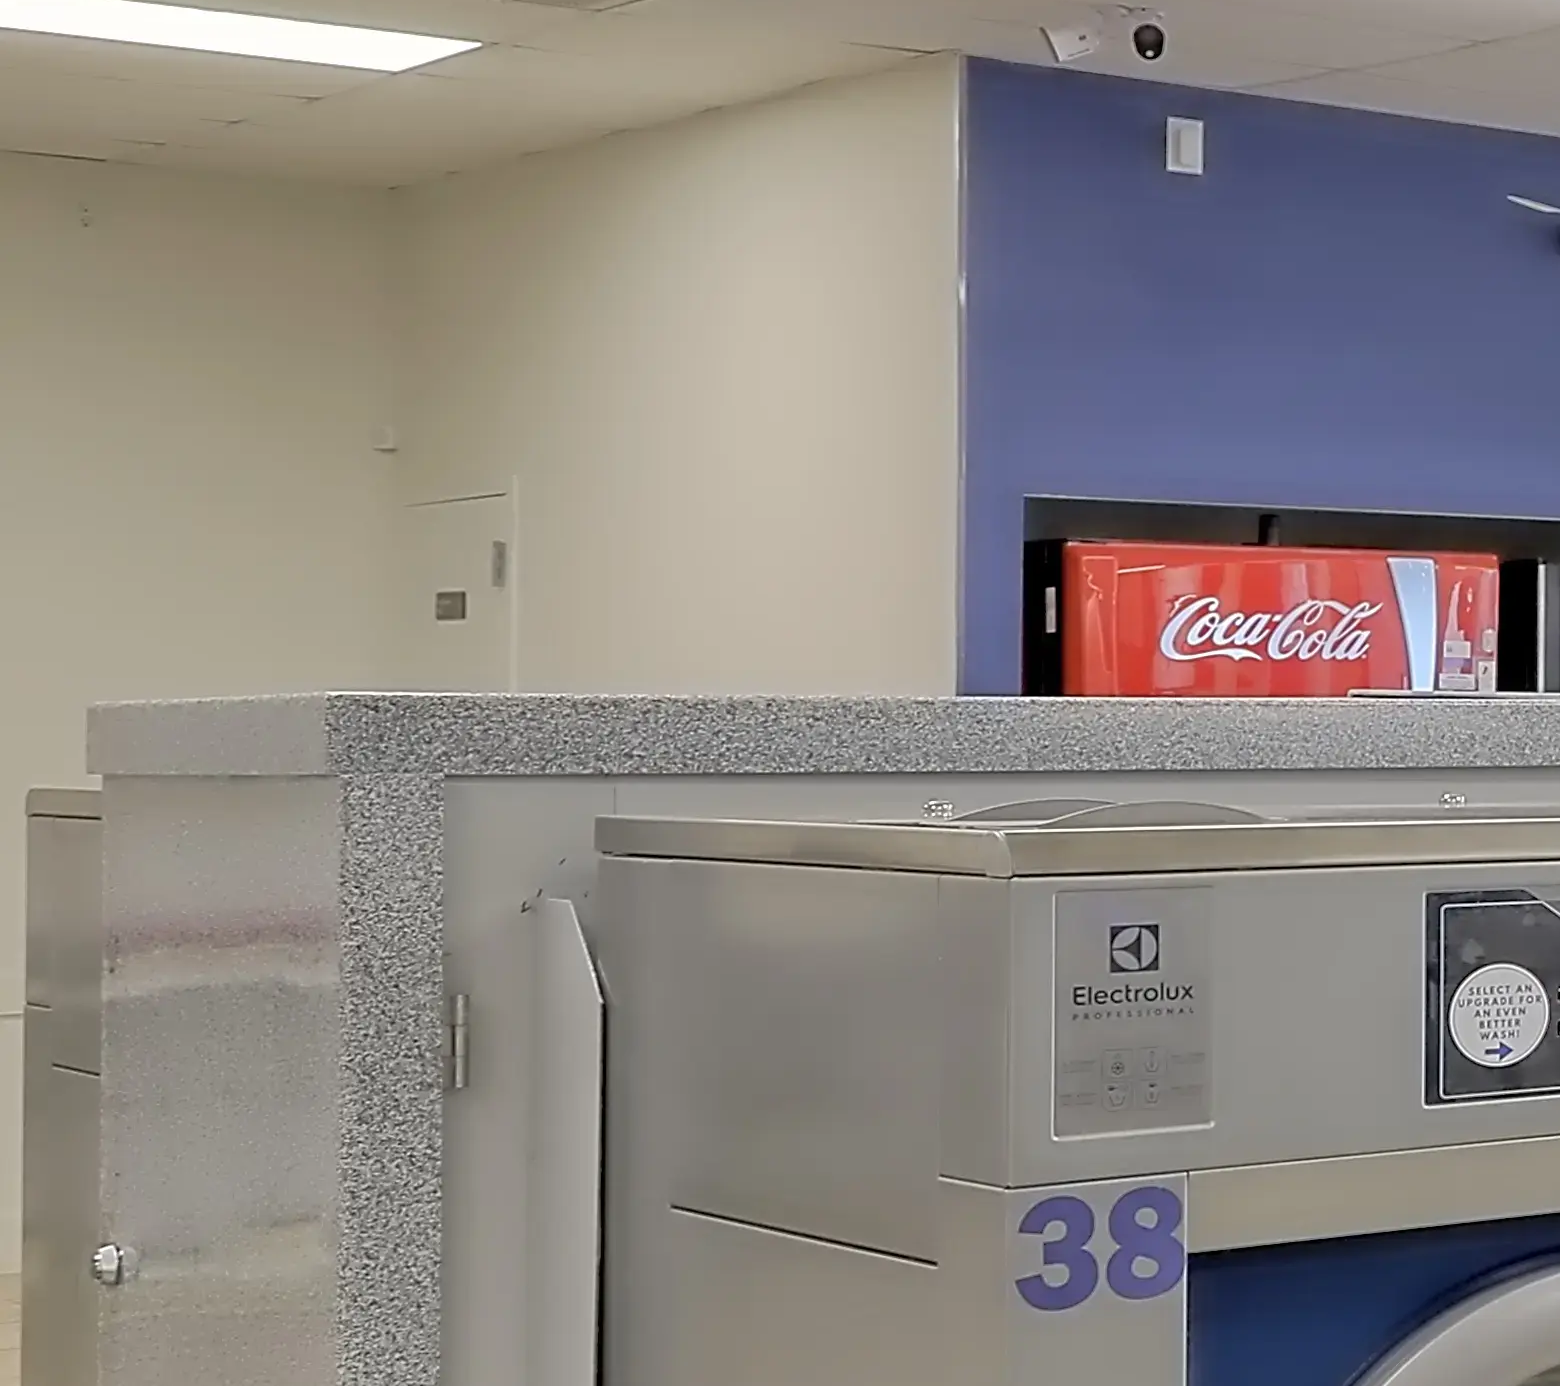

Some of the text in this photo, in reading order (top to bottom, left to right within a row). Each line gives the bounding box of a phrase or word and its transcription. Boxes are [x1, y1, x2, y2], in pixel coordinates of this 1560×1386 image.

[1160, 594, 1384, 662] Coca-Cola
[1072, 981, 1195, 1006] Electrolux
[1467, 983, 1533, 996] SELECT AN
[1457, 995, 1542, 1008] UPGRADE FOR
[1473, 1006, 1527, 1018] AN EVEN
[1478, 1018, 1522, 1029] BETTER
[1479, 1029, 1521, 1041] WASH!
[1014, 1186, 1186, 1311] 38
